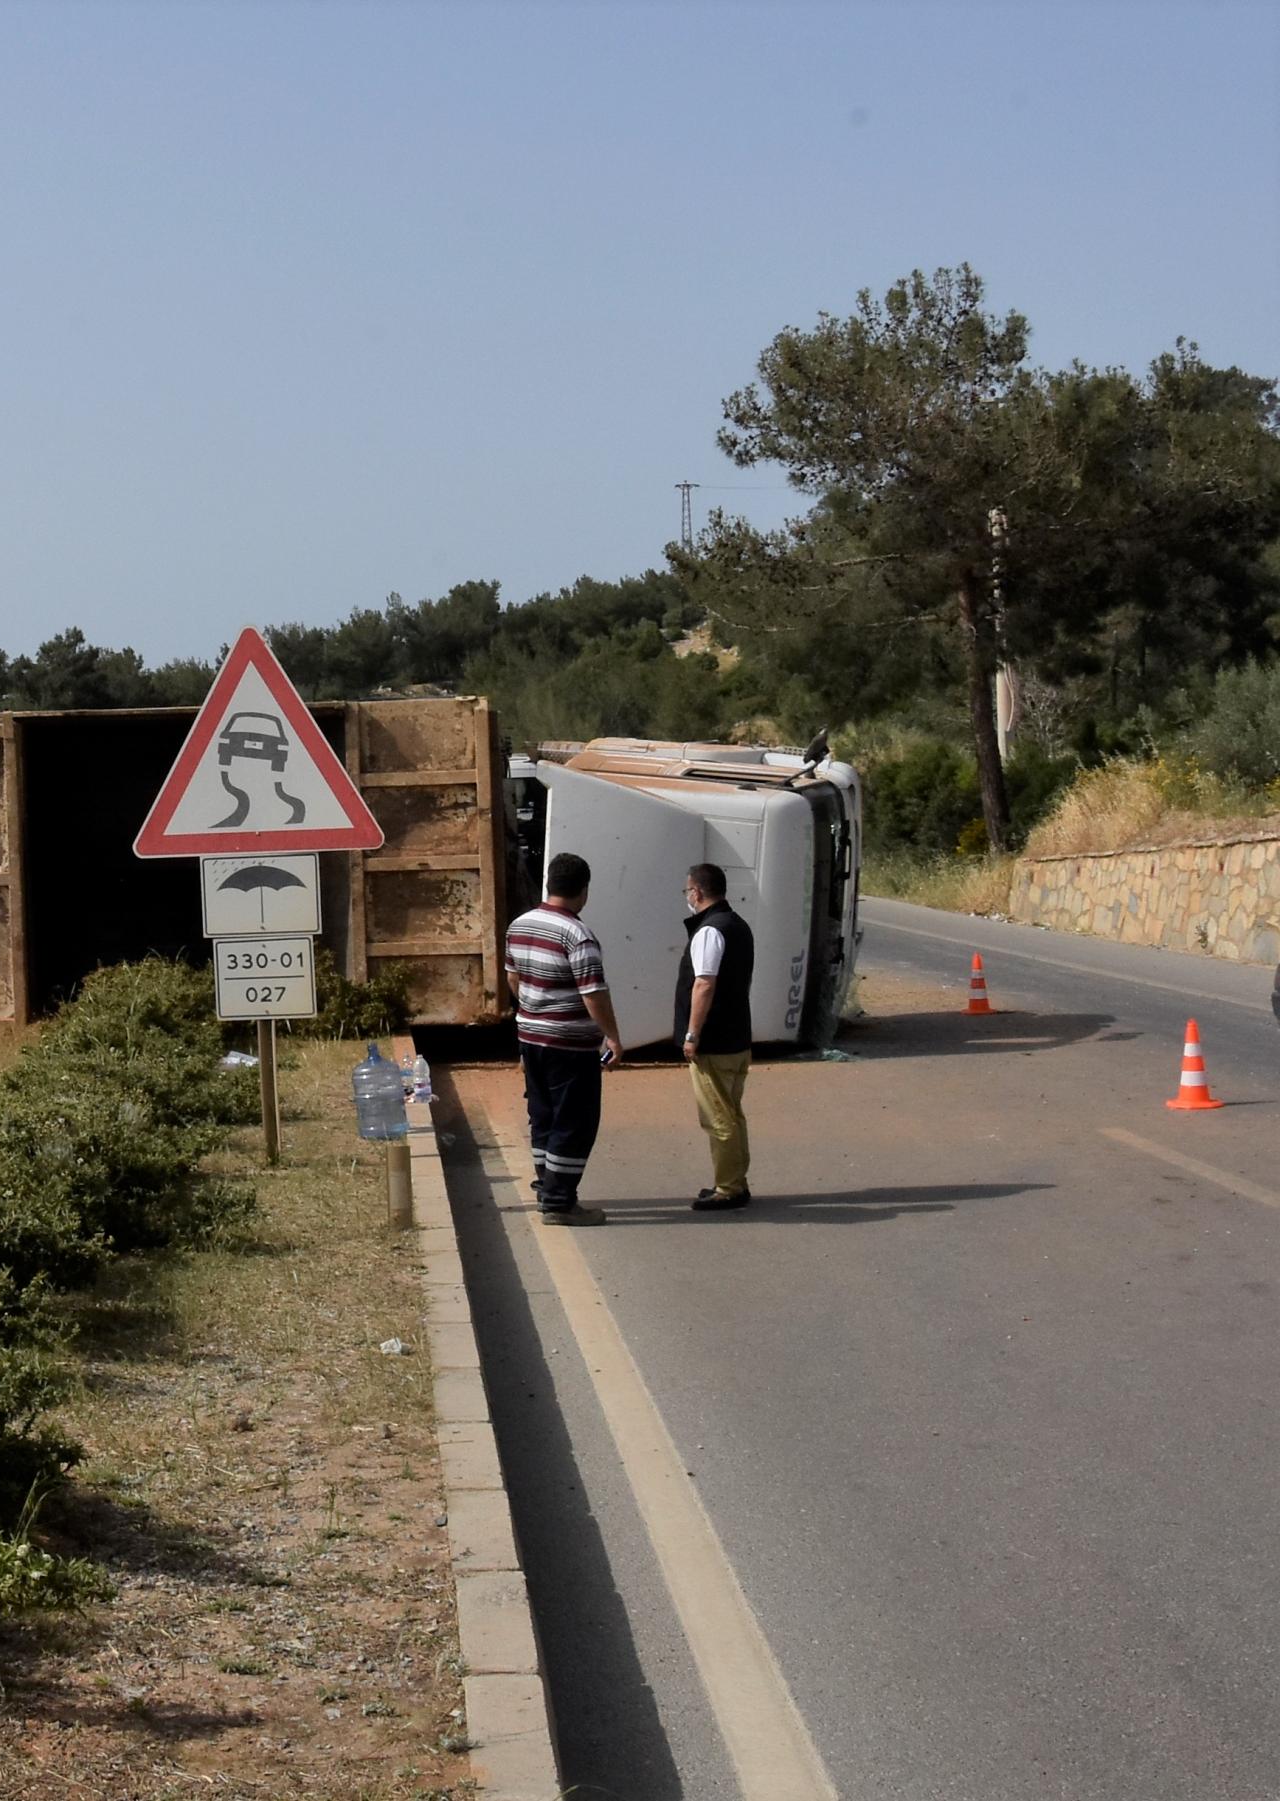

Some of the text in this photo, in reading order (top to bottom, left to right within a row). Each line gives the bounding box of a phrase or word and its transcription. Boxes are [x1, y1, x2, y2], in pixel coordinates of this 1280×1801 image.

[226, 952, 304, 970] 330-01
[245, 987, 286, 1003] 027
[784, 948, 805, 1029] AREL
